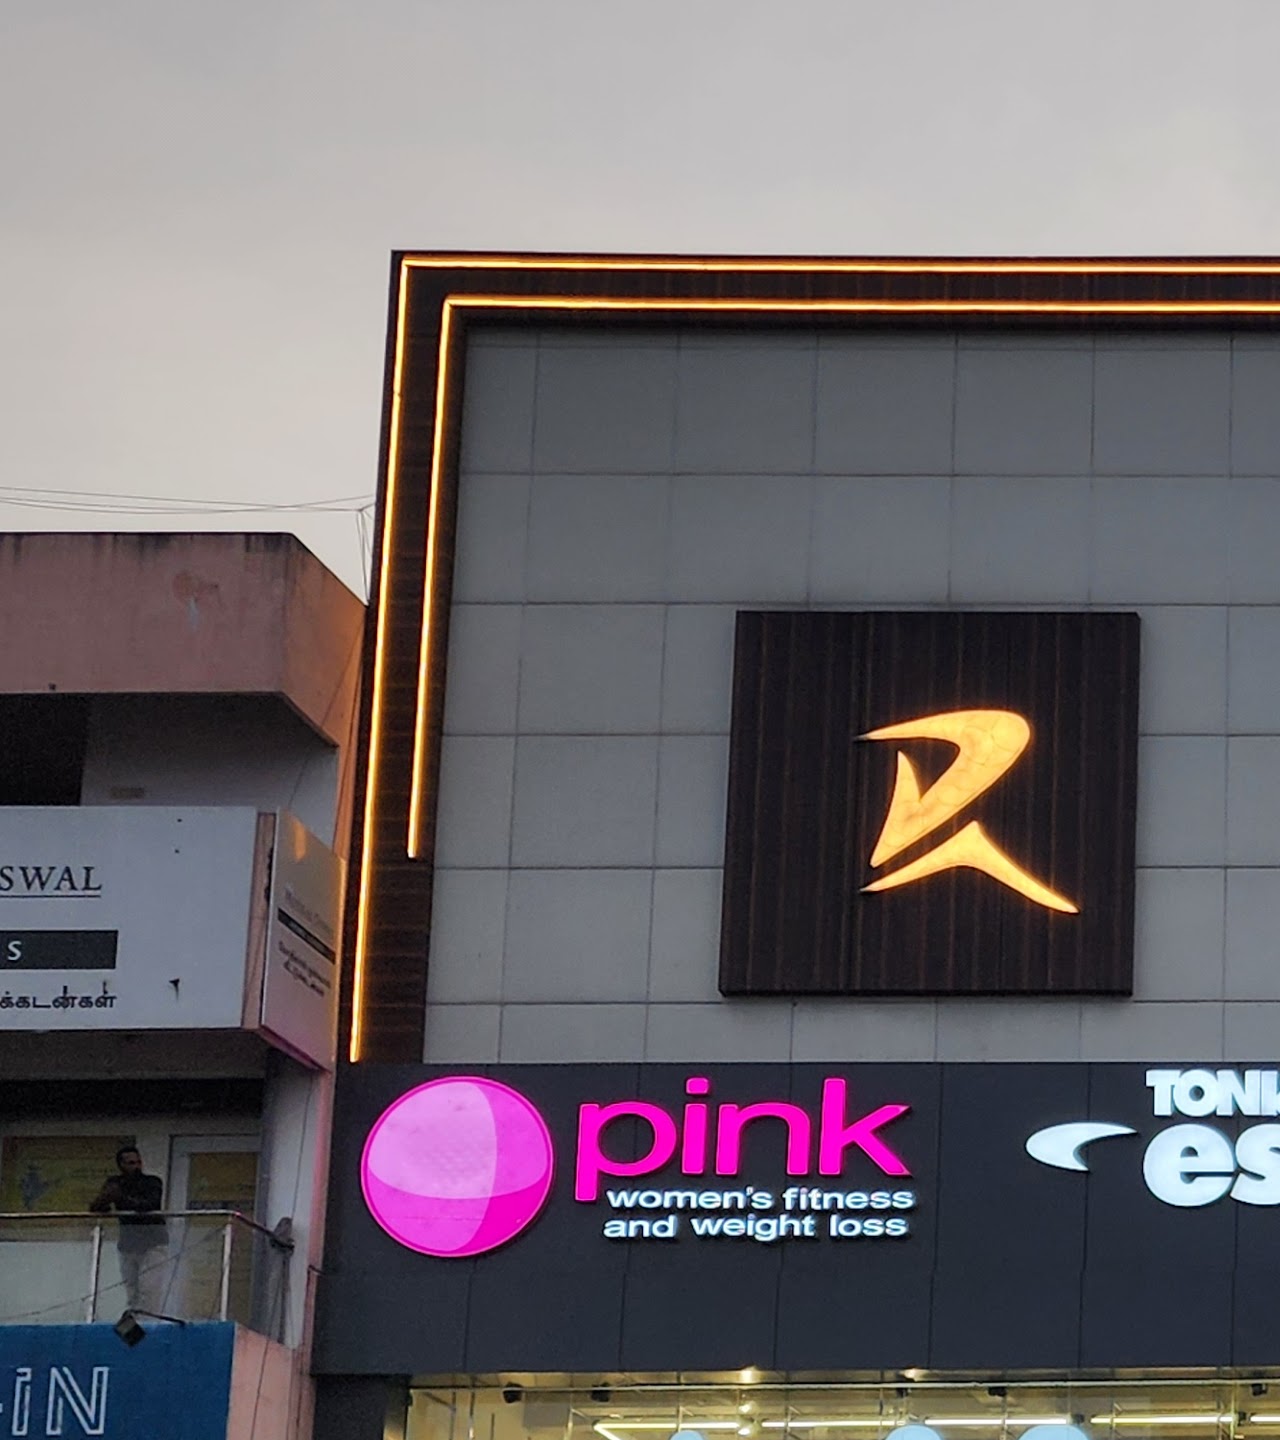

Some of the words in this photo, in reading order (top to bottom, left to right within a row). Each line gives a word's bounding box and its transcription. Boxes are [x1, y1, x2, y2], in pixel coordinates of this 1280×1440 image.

[575, 1075, 912, 1202] pink
[606, 1186, 774, 1211] women's
[781, 1185, 915, 1210] fitness
[603, 1212, 675, 1239] and
[690, 1212, 815, 1242] weight
[829, 1212, 908, 1238] loss
